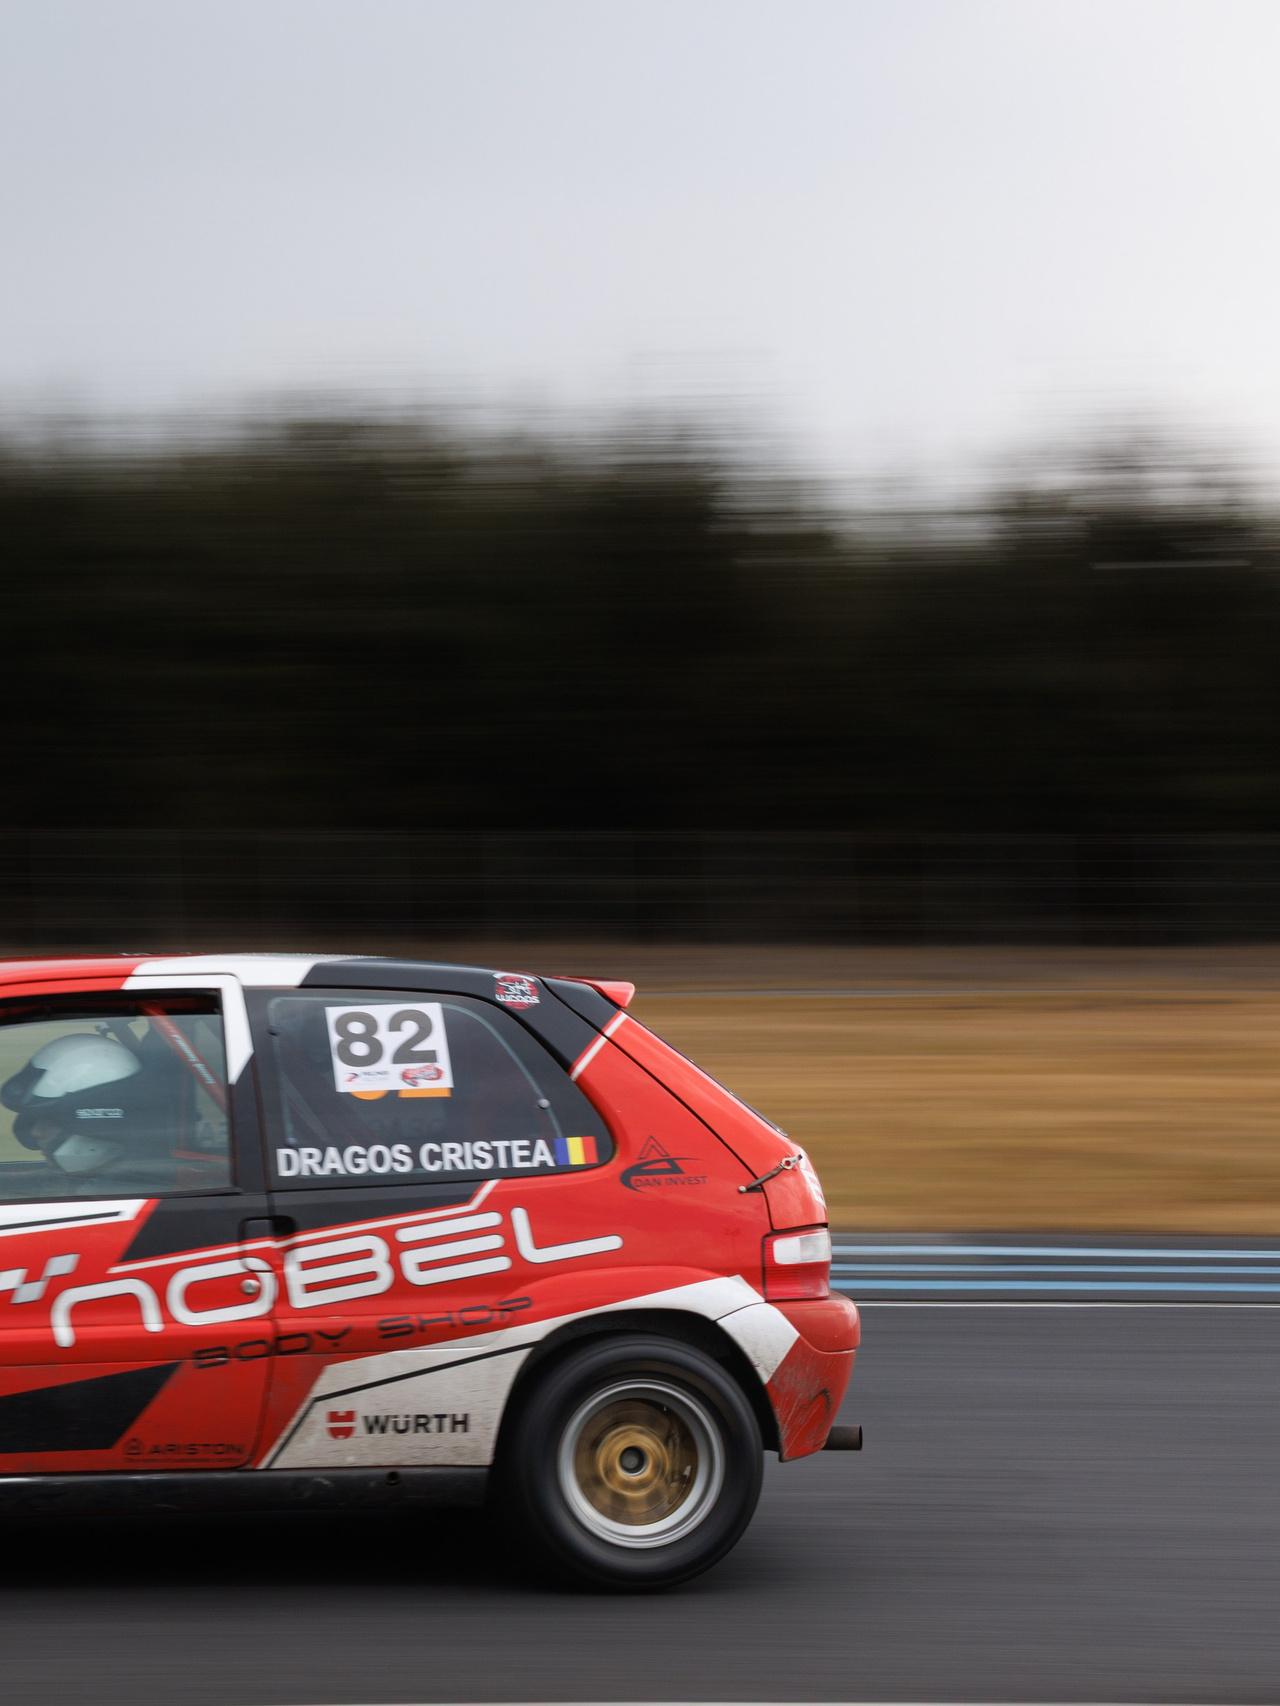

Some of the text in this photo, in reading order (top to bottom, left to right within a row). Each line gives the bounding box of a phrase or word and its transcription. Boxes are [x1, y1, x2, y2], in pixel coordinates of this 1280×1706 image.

[334, 1009, 438, 1068] 82
[276, 1138, 556, 1177] DRAGOS CRISTEA
[633, 1175, 708, 1188] DAN INVEST
[193, 1296, 533, 1370] BODY SHOP
[361, 1412, 470, 1435] WÜRTH
[149, 1443, 244, 1456] ARISTON
